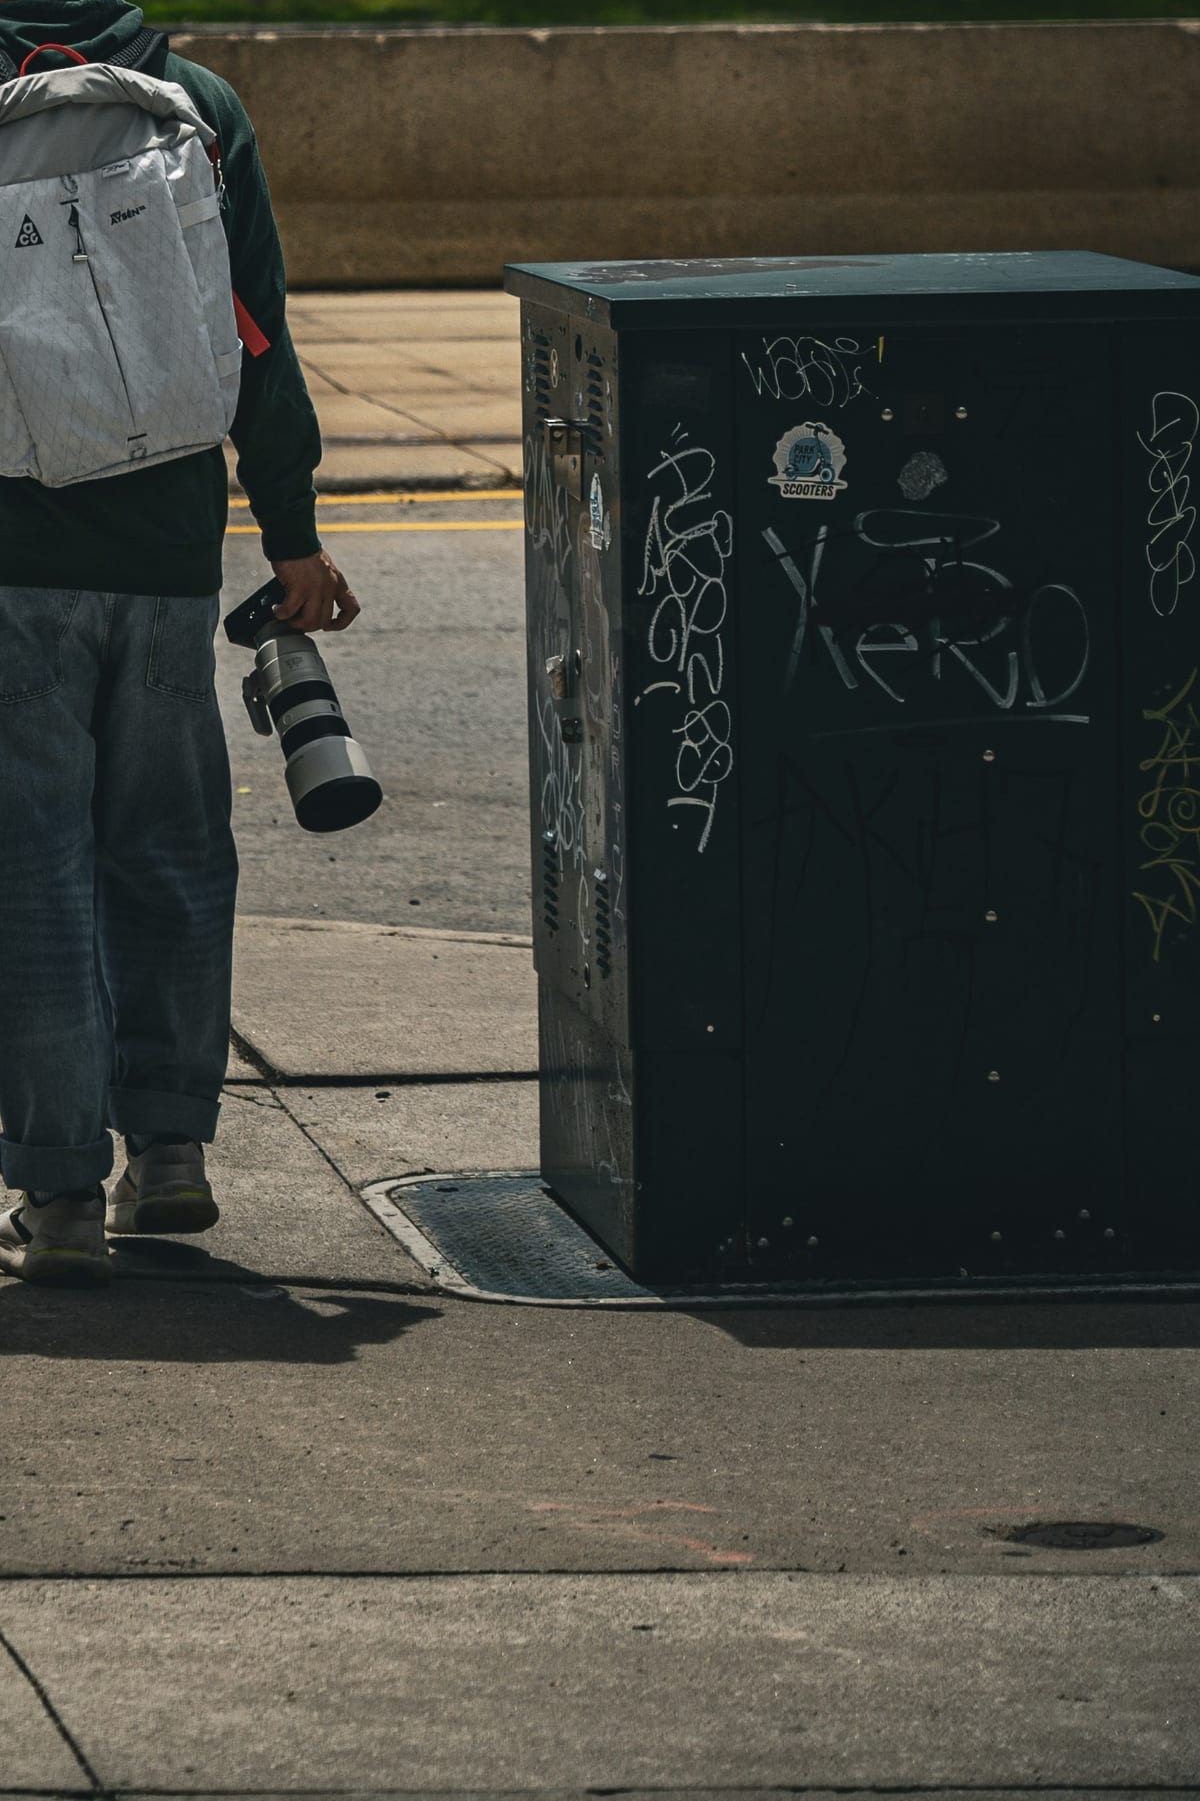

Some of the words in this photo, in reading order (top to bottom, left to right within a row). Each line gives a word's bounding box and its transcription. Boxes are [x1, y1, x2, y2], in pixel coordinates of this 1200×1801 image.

[794, 444, 815, 454] PARK
[794, 454, 813, 465] CITY
[782, 483, 834, 497] SCOOTERS
